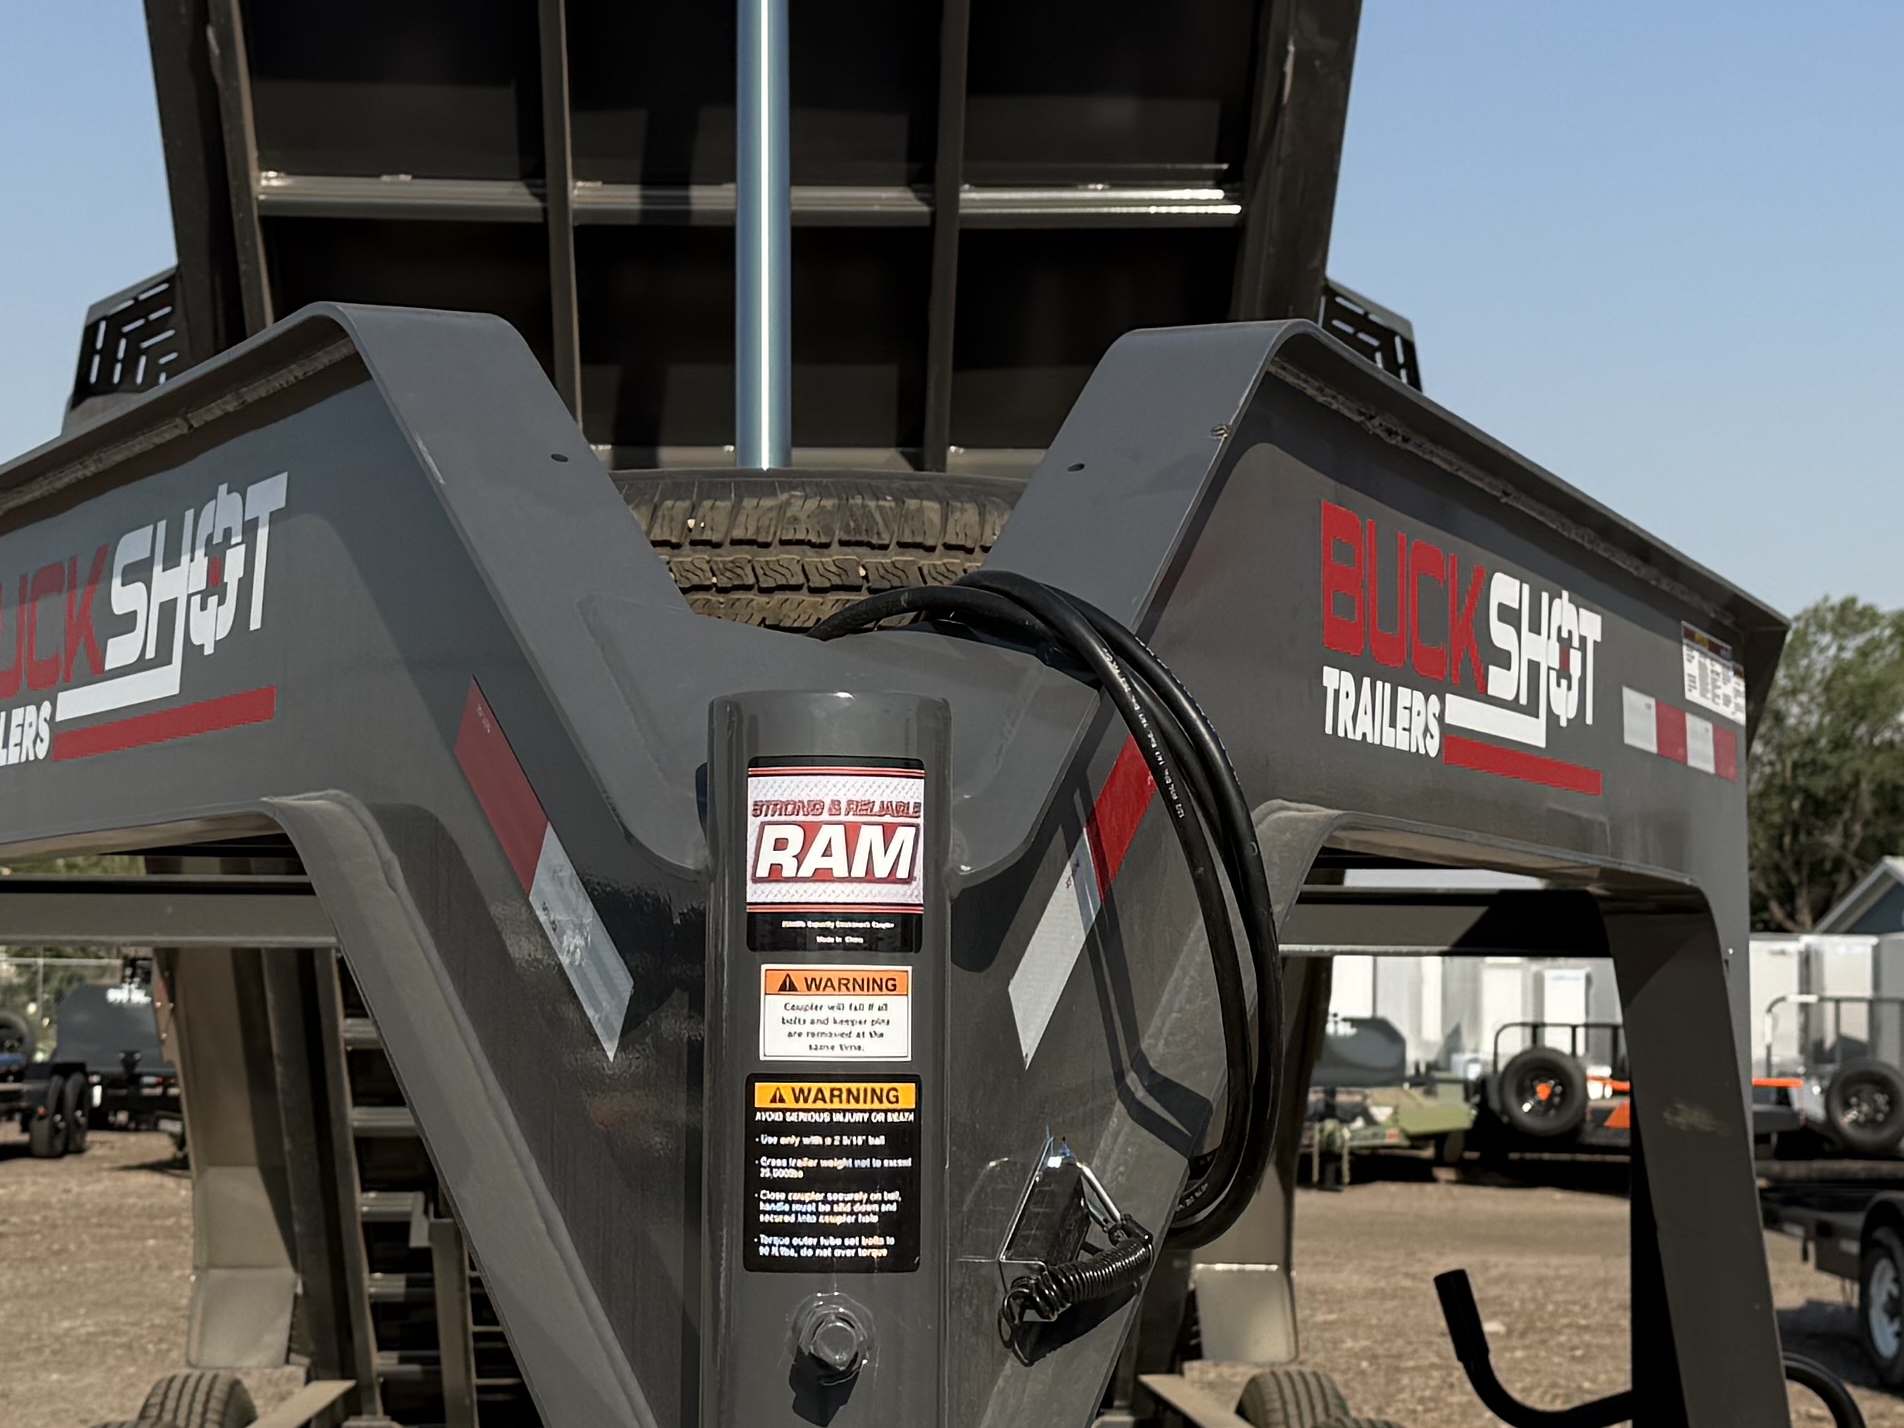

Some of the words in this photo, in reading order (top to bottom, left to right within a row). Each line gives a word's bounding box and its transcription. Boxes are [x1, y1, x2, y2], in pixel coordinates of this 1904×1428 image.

[1322, 665, 1441, 757] TRAILERS
[755, 824, 916, 879] RAM
[804, 976, 898, 992] WARNING
[791, 1086, 900, 1105] WARNING
